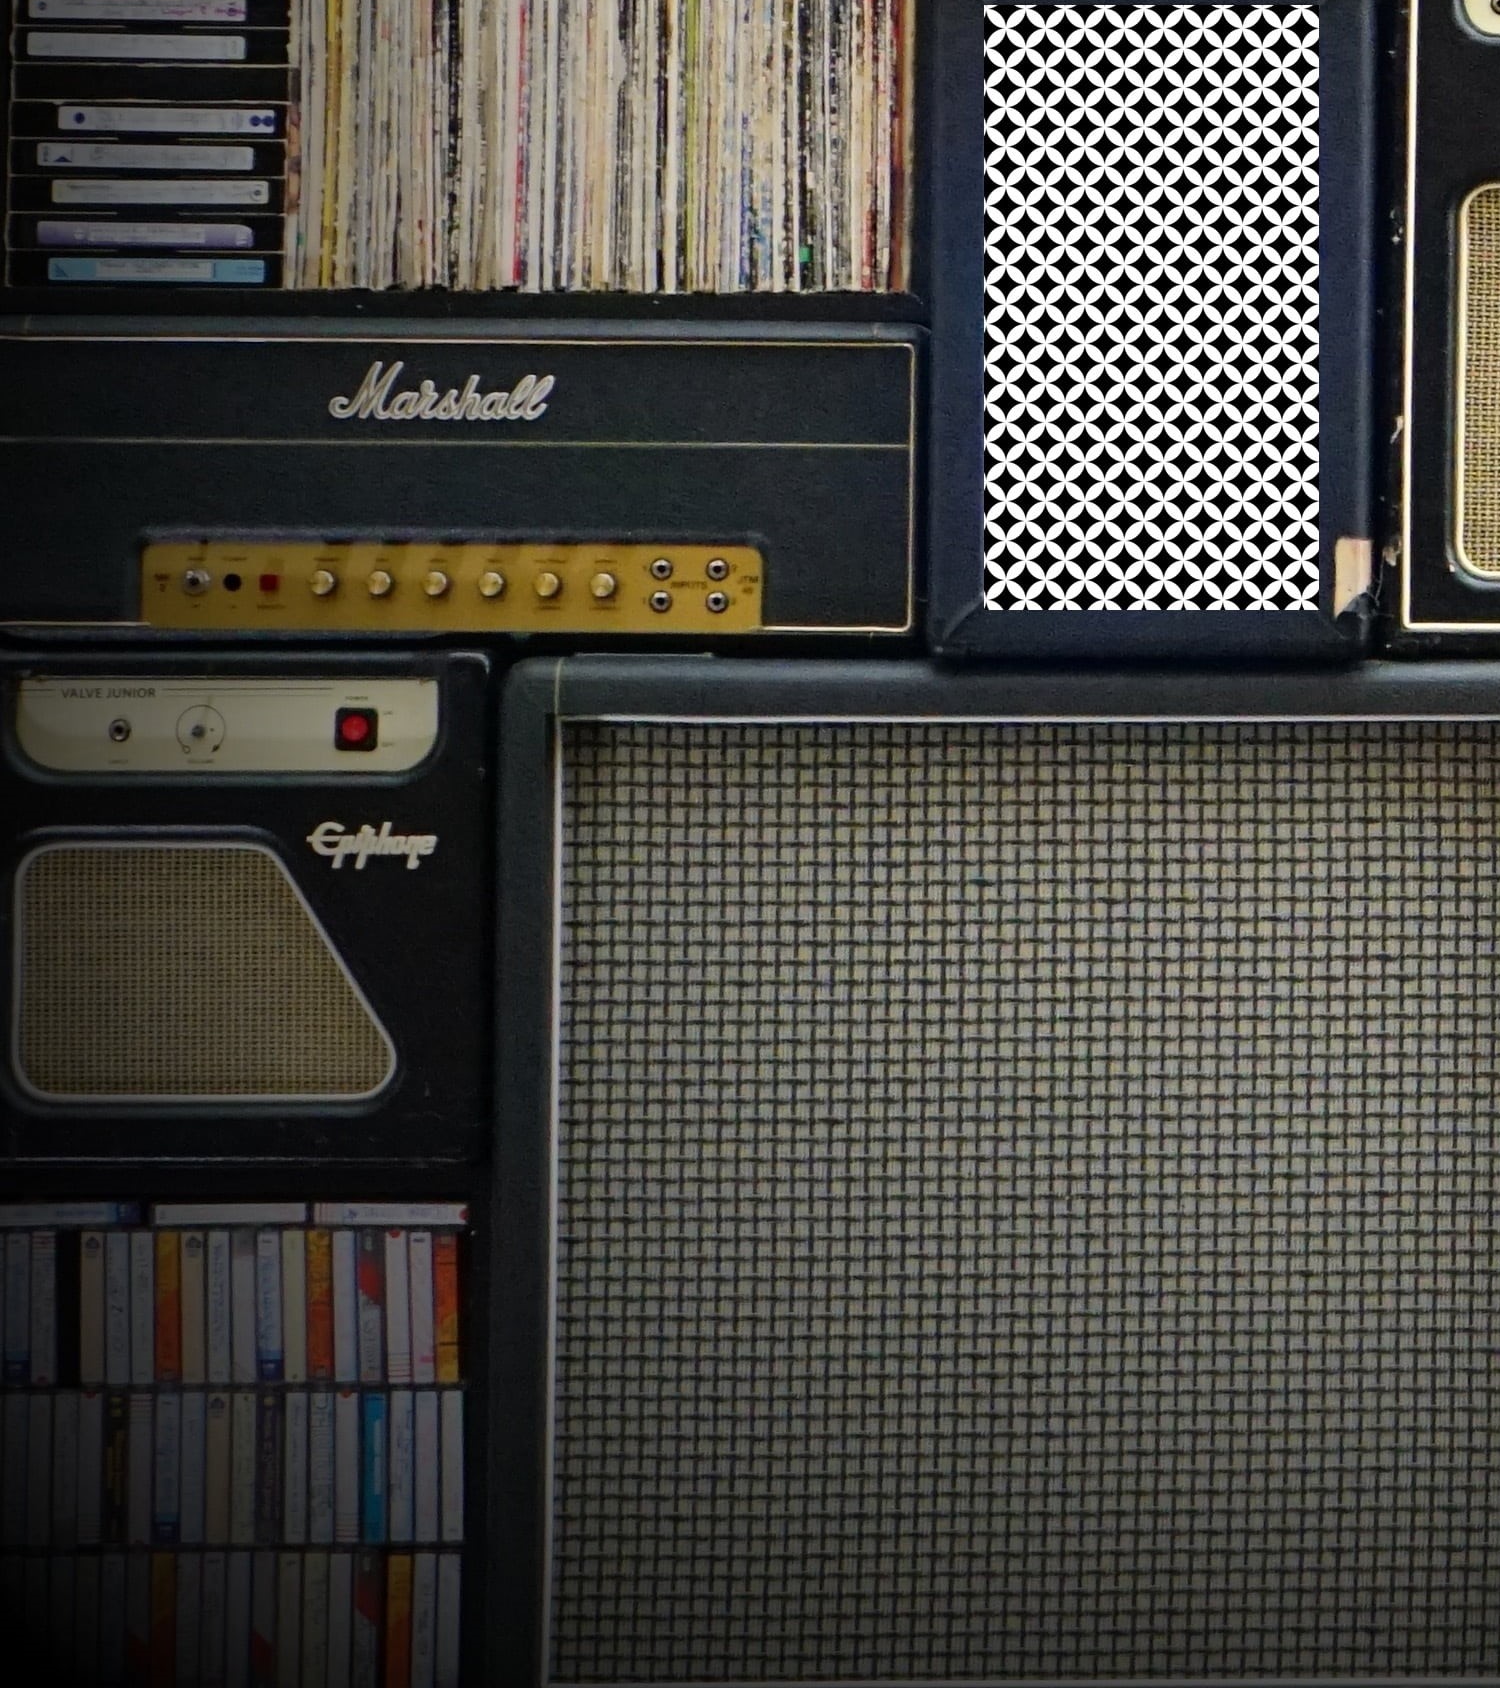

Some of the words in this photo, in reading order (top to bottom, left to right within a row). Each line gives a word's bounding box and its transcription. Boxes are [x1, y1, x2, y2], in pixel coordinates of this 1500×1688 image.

[329, 361, 556, 424] Marshall
[62, 687, 103, 699] VALVE
[106, 687, 156, 699] JUNIOR
[307, 821, 438, 870] Epiphone
